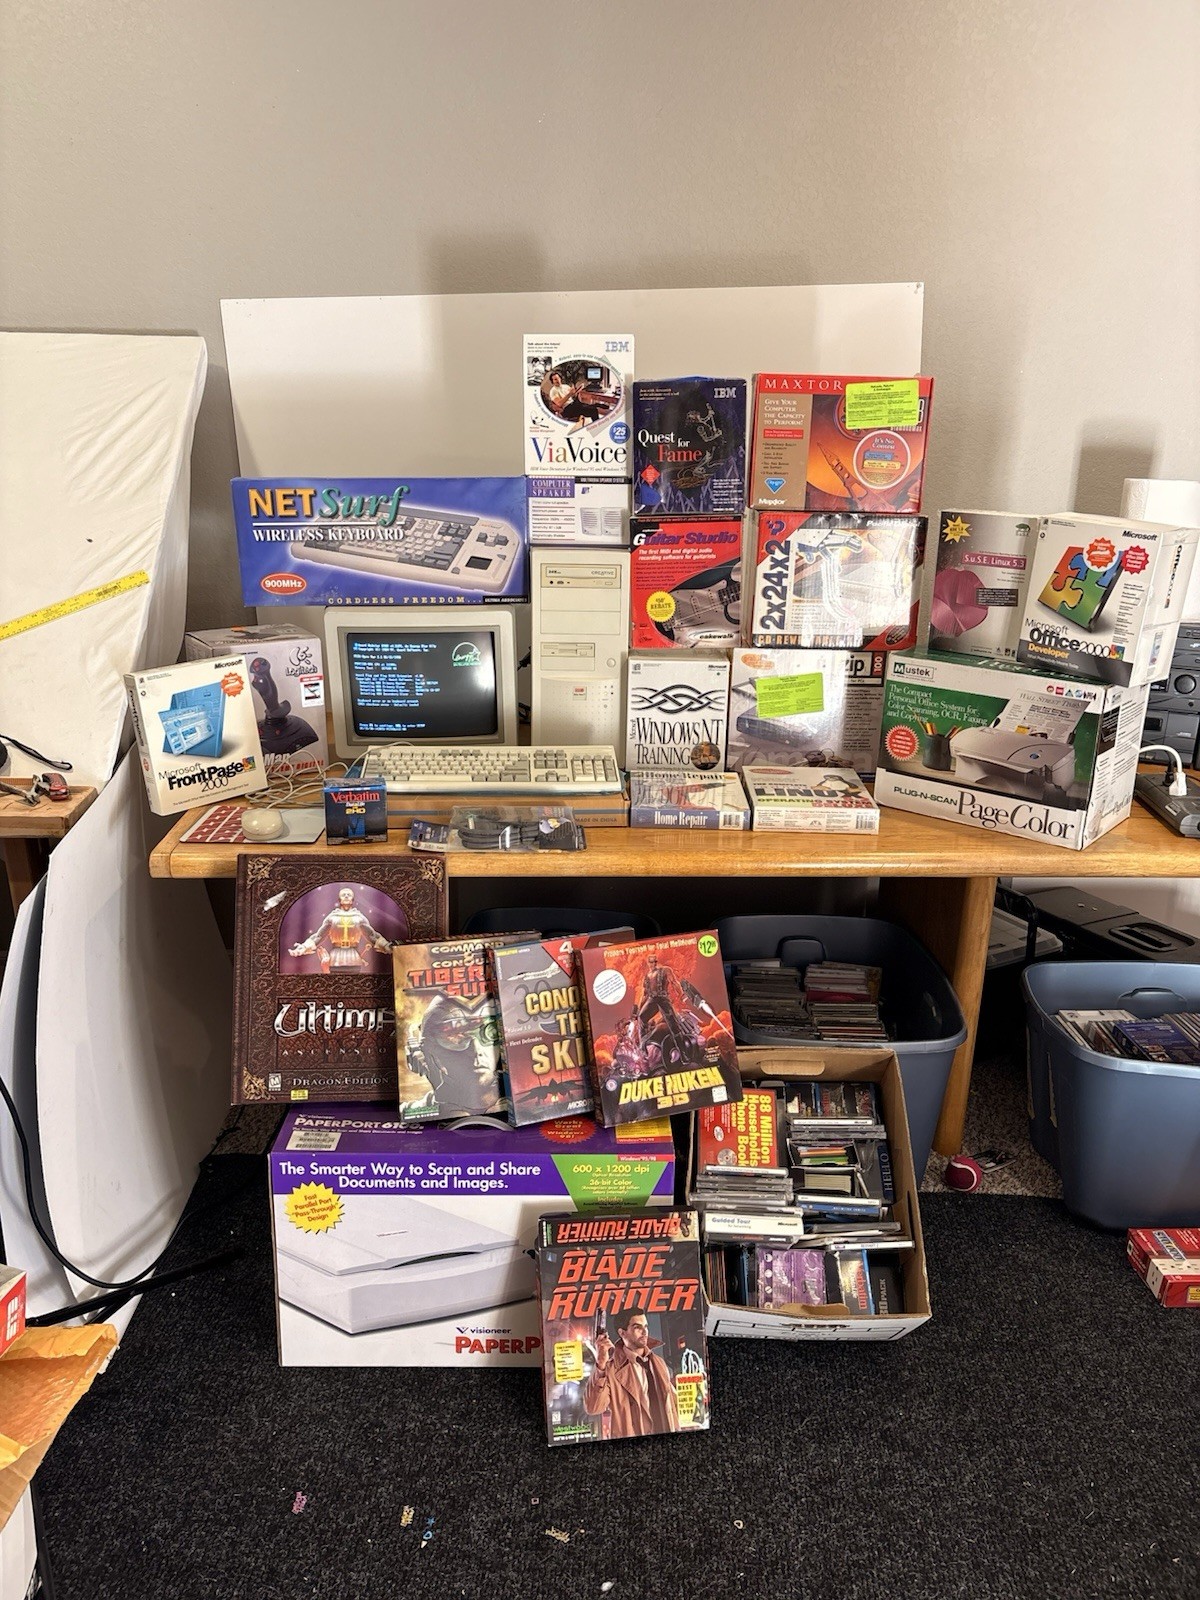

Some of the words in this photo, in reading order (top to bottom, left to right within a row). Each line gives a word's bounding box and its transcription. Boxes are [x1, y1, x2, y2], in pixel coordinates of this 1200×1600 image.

[605, 341, 630, 352] IBM
[764, 378, 843, 391] MAXTOR
[714, 387, 736, 399] IBM
[613, 427, 626, 435] $25
[638, 429, 676, 448] Quest
[530, 436, 627, 464] ViaVoice
[678, 438, 690, 448] for
[658, 444, 702, 462] Fame
[532, 480, 571, 488] COMPUTER
[532, 489, 571, 497] SPEAKER
[253, 529, 324, 542] WIRELESS
[328, 528, 405, 542] KEYBOARD
[633, 532, 684, 546] Guitar
[684, 531, 738, 544] Studio
[1122, 530, 1158, 541] Microsoft
[991, 557, 1011, 566] Linux
[1013, 559, 1025, 568] 5.3
[264, 580, 303, 588] 900MHz
[760, 540, 791, 630] 2x24x2
[328, 596, 395, 604] CORDLESS
[1025, 618, 1069, 635] Microsoft
[1028, 643, 1070, 659] Developer
[214, 659, 243, 670] Microsoft
[286, 664, 318, 677] Logitech
[874, 656, 883, 672] 100
[894, 662, 930, 676] Mustek
[890, 684, 902, 692] The
[903, 686, 932, 697] Compact
[889, 693, 917, 703] Personal
[919, 698, 939, 707] Office
[940, 701, 966, 713] System
[887, 709, 900, 717] and
[888, 700, 906, 710] Color
[942, 710, 961, 720] OCR,
[964, 714, 988, 726] Faxing
[637, 718, 700, 745] WINDOWS
[702, 719, 724, 745] NT
[635, 744, 690, 765] TRAINING
[158, 762, 202, 781] Microsoft
[168, 762, 244, 790] FrontPage
[201, 776, 228, 793] 2000
[330, 791, 380, 803] Verbatim
[754, 788, 866, 799] LINUX
[893, 787, 958, 806] PLUG-N-SCAN
[654, 811, 678, 825] Home
[679, 811, 709, 828] Repair
[957, 790, 1075, 840] PageColor
[431, 941, 504, 954] COMMAND
[559, 942, 573, 954] 4
[432, 958, 484, 968] CONQU
[408, 966, 484, 987] TIBER
[556, 1011, 583, 1036] TH
[282, 1047, 387, 1056] ASCENSIO
[531, 1037, 587, 1075] SKI
[293, 1078, 341, 1086] DRAGON
[344, 1077, 389, 1085] EDITION
[618, 1076, 664, 1105] DUKE
[665, 1066, 726, 1096] NUKEM
[657, 1093, 690, 1110] 3D
[760, 1095, 772, 1113] 88
[294, 1118, 381, 1129] PAPERPORT
[748, 1094, 760, 1167] Households
[760, 1116, 773, 1164] Million
[737, 1136, 749, 1166] Book
[279, 1162, 305, 1175] The
[310, 1162, 366, 1176] Smarter
[370, 1163, 404, 1179] Way
[408, 1164, 424, 1176] to
[428, 1162, 462, 1176] Scan
[466, 1162, 496, 1176] and
[500, 1162, 542, 1176] Share
[572, 1165, 592, 1173] 600
[634, 1164, 650, 1174] dpi
[880, 1152, 893, 1191] HELLO
[338, 1176, 416, 1188] Documents
[420, 1175, 448, 1188] and
[452, 1176, 509, 1192] Images.
[294, 1200, 318, 1210] Parallel
[304, 1194, 317, 1202] Fast
[307, 1214, 329, 1222] Design
[557, 1219, 628, 1244] RUNNER
[628, 1218, 682, 1239] BLADE
[558, 1245, 671, 1284] BLADE
[548, 1278, 699, 1321] RUNNER
[455, 1336, 540, 1354] PAPERP
